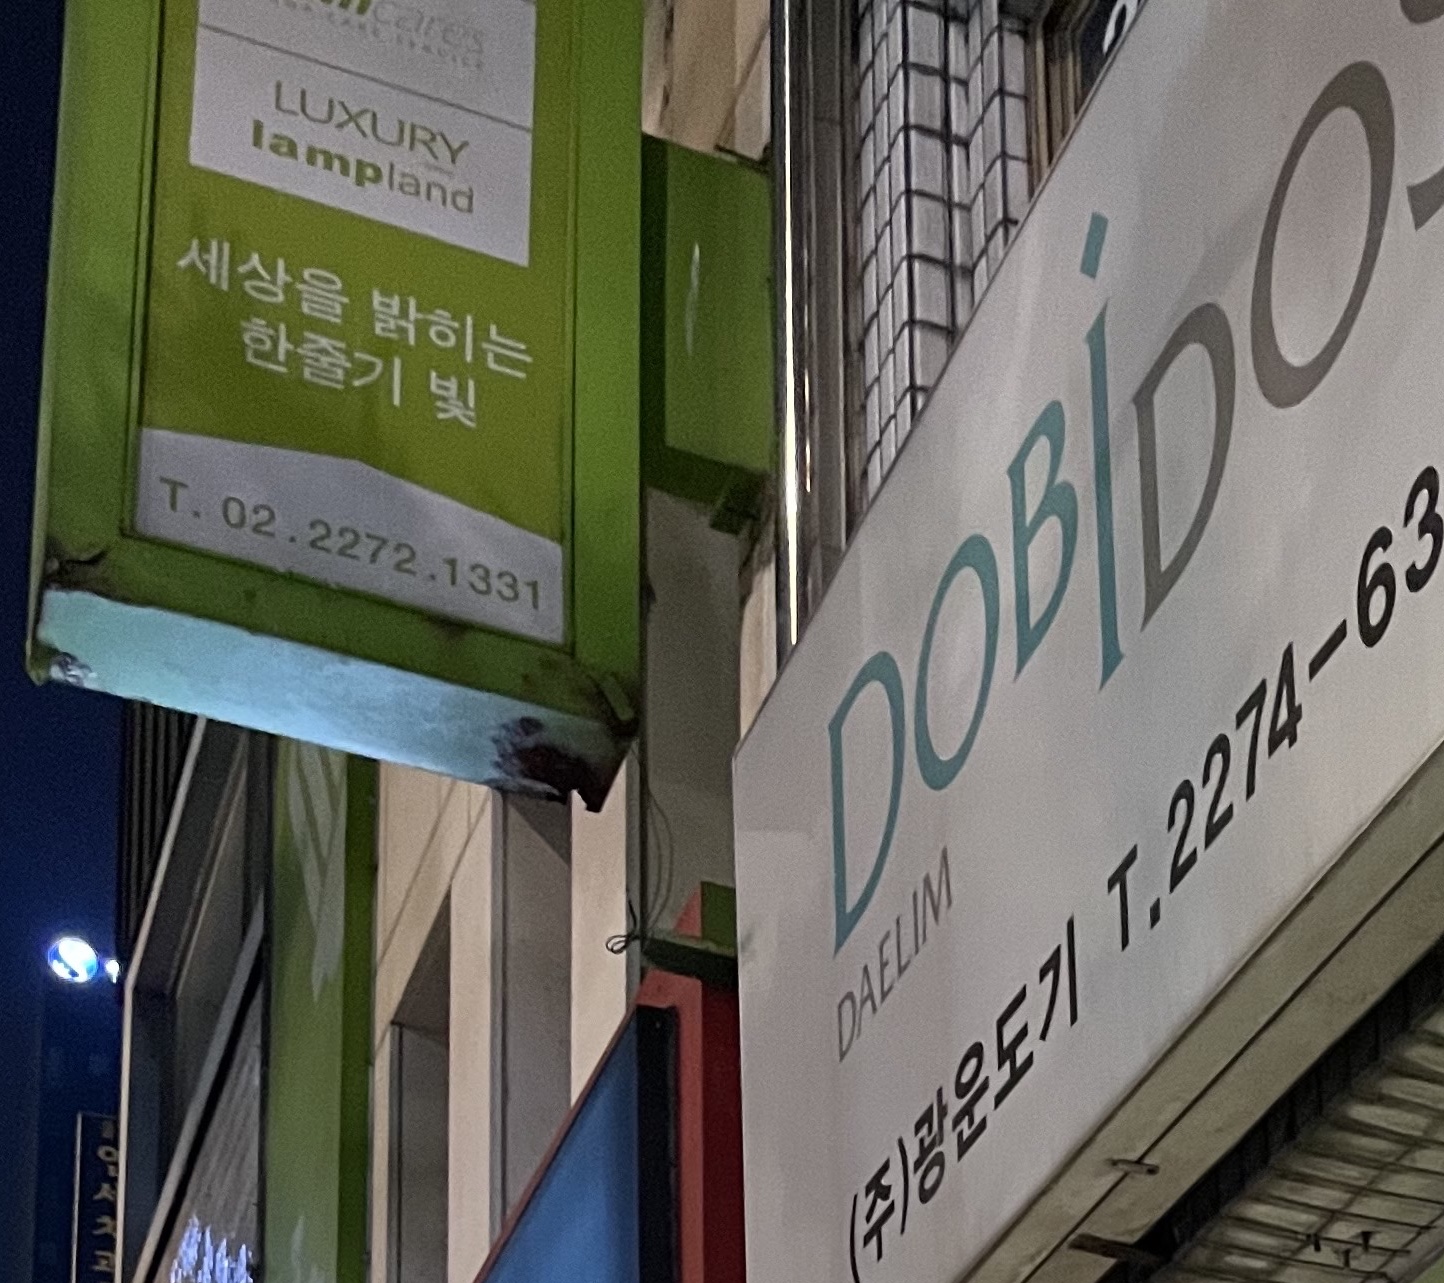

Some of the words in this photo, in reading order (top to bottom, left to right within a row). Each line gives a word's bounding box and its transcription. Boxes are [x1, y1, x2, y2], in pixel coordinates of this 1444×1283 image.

[252, 119, 474, 214] lampland
[275, 80, 470, 165] LUXURY
[177, 238, 350, 325] 세상을
[372, 288, 532, 380] 밝히는
[241, 316, 402, 407] 한줄기
[430, 370, 477, 428] 빛
[160, 477, 201, 520] T.
[221, 496, 542, 611] 02.2272.1331
[837, 845, 952, 1063] DAELIM
